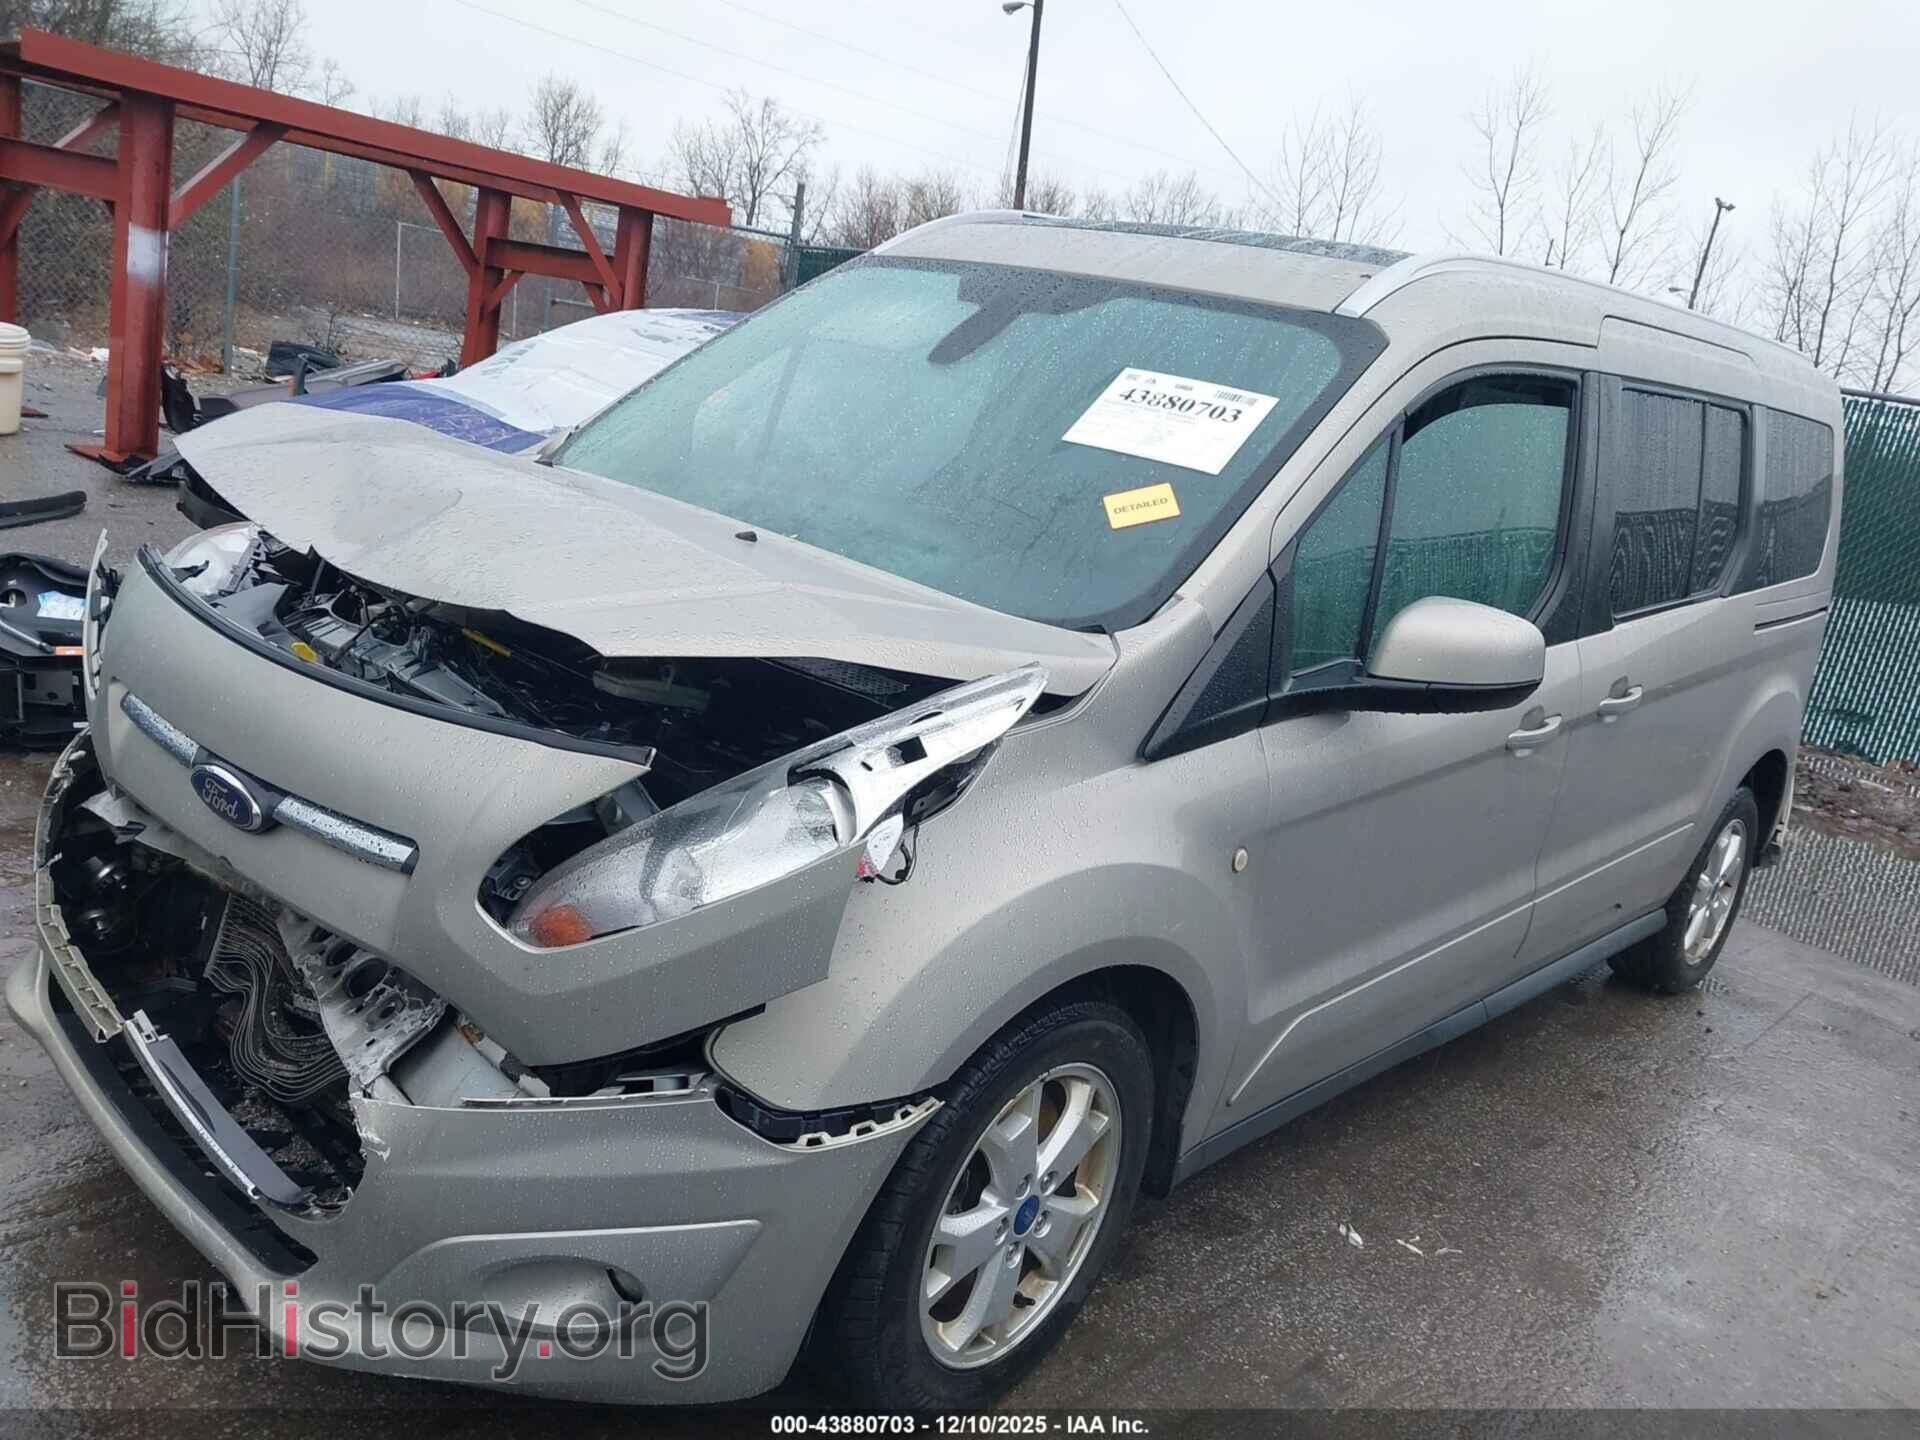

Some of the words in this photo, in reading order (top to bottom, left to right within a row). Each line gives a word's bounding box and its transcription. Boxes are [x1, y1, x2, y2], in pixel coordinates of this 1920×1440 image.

[1119, 388, 1243, 424] 43880703
[1113, 497, 1169, 515] DETAILED
[202, 778, 239, 819] Ford
